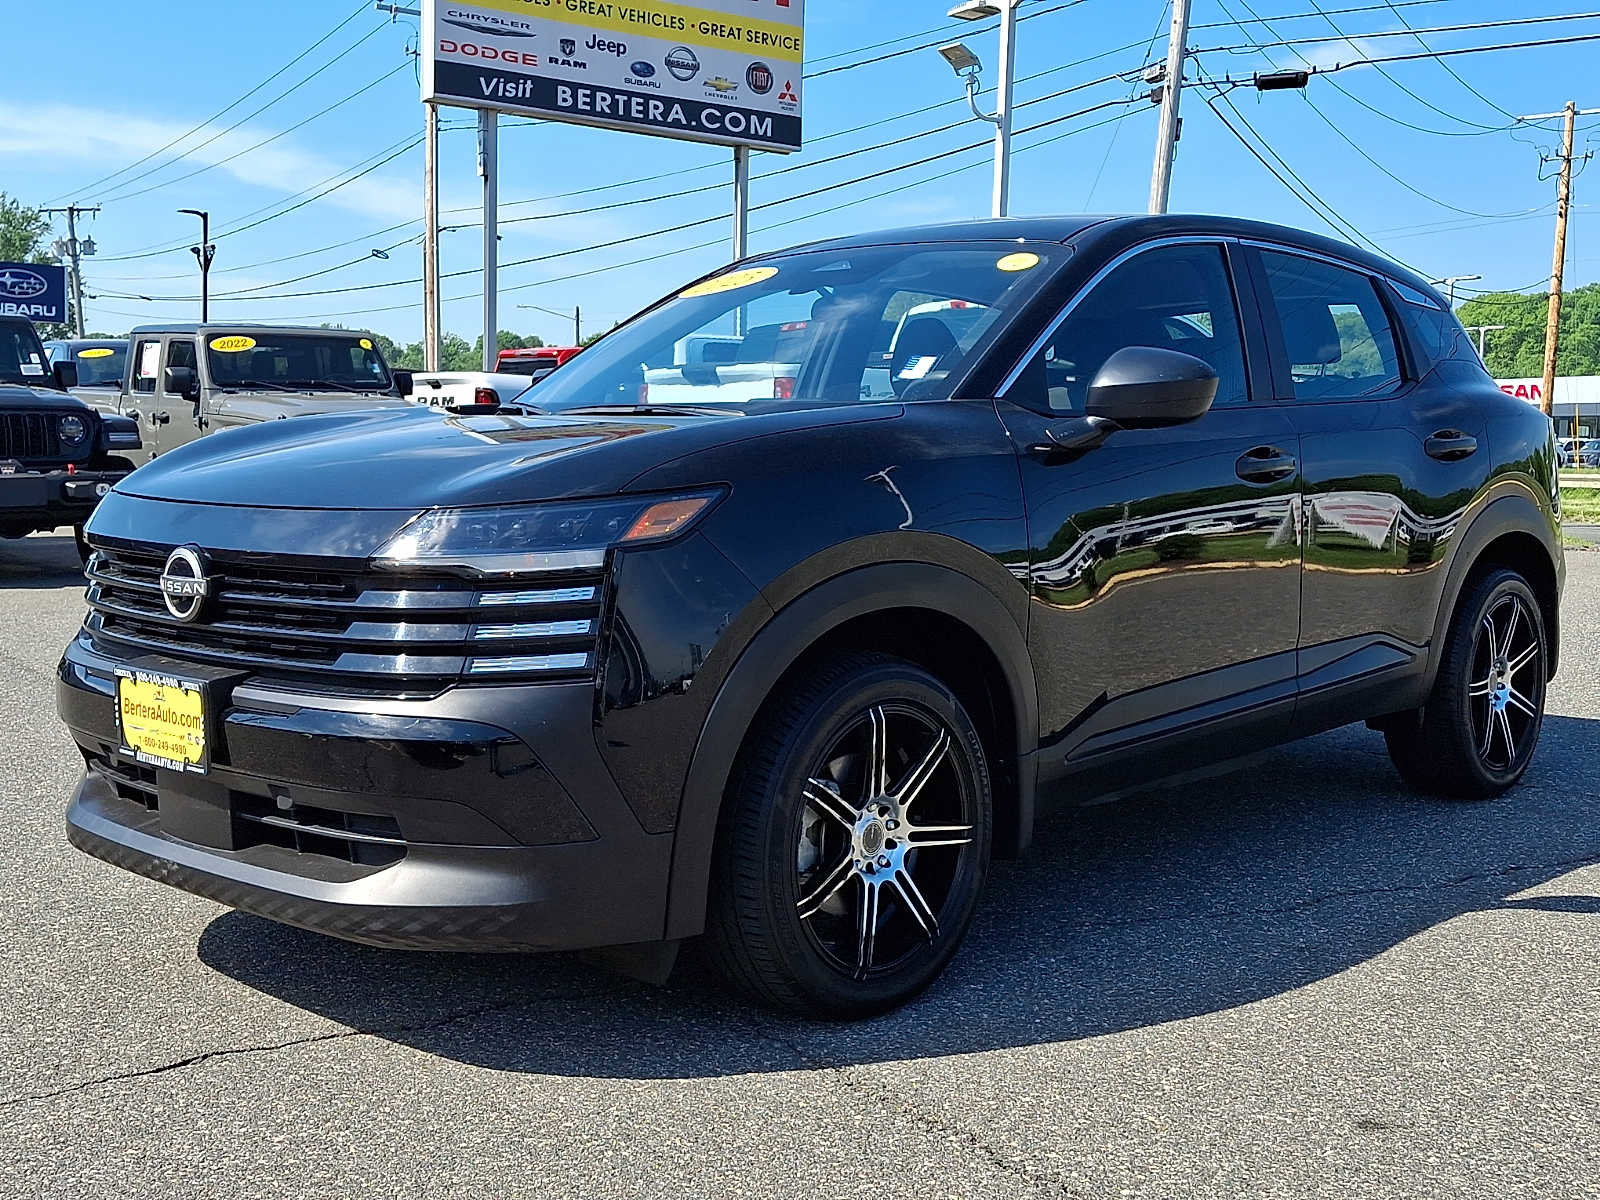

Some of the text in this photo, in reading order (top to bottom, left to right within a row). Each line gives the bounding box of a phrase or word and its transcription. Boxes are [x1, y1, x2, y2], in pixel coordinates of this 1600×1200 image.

[447, 10, 531, 30] CHRYSLER
[566, 0, 800, 51] GREAT VEHICLES GREAT SERVICE
[440, 40, 538, 66] DODGE
[585, 34, 627, 57] Jeep
[548, 56, 587, 69] RAM
[668, 59, 698, 69] NISSAN
[624, 77, 661, 88] SUBARU
[752, 71, 769, 87] FIAT
[704, 91, 738, 101] CHEVROLET
[480, 77, 772, 137] Visit BERTERA.COM
[219, 338, 248, 349] 2022
[123, 697, 201, 730] BerteraAuto.com
